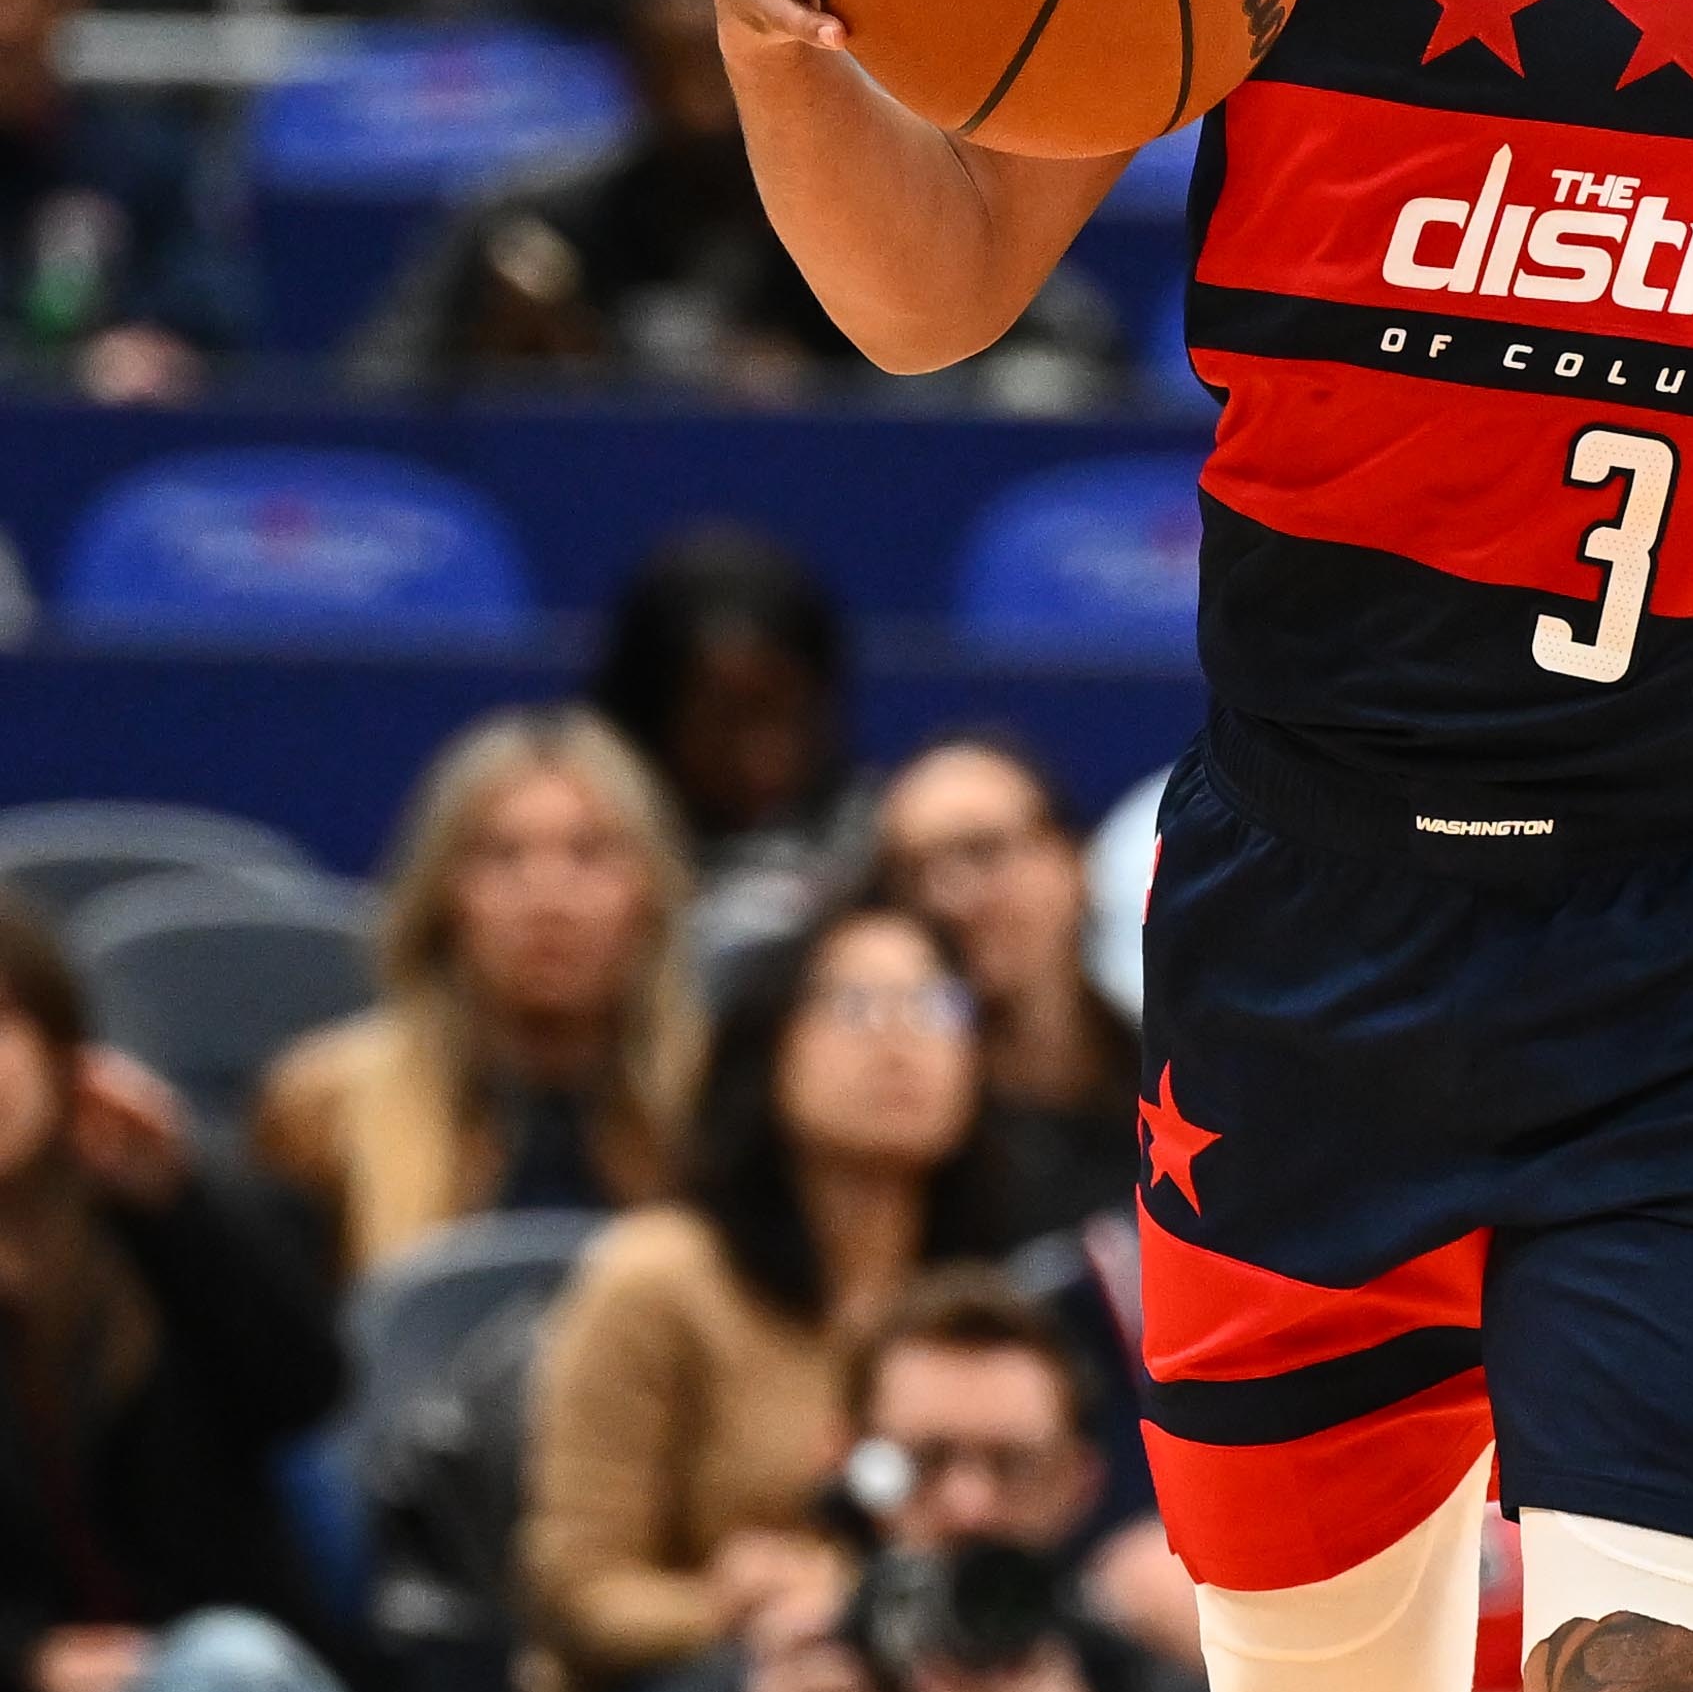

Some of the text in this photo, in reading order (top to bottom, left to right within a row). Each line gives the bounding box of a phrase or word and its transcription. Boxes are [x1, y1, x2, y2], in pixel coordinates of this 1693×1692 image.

[1550, 168, 1641, 211] THE
[1380, 327, 1453, 358] OF
[1531, 430, 1674, 684] 3
[1415, 815, 1555, 837] WASHINGTON
